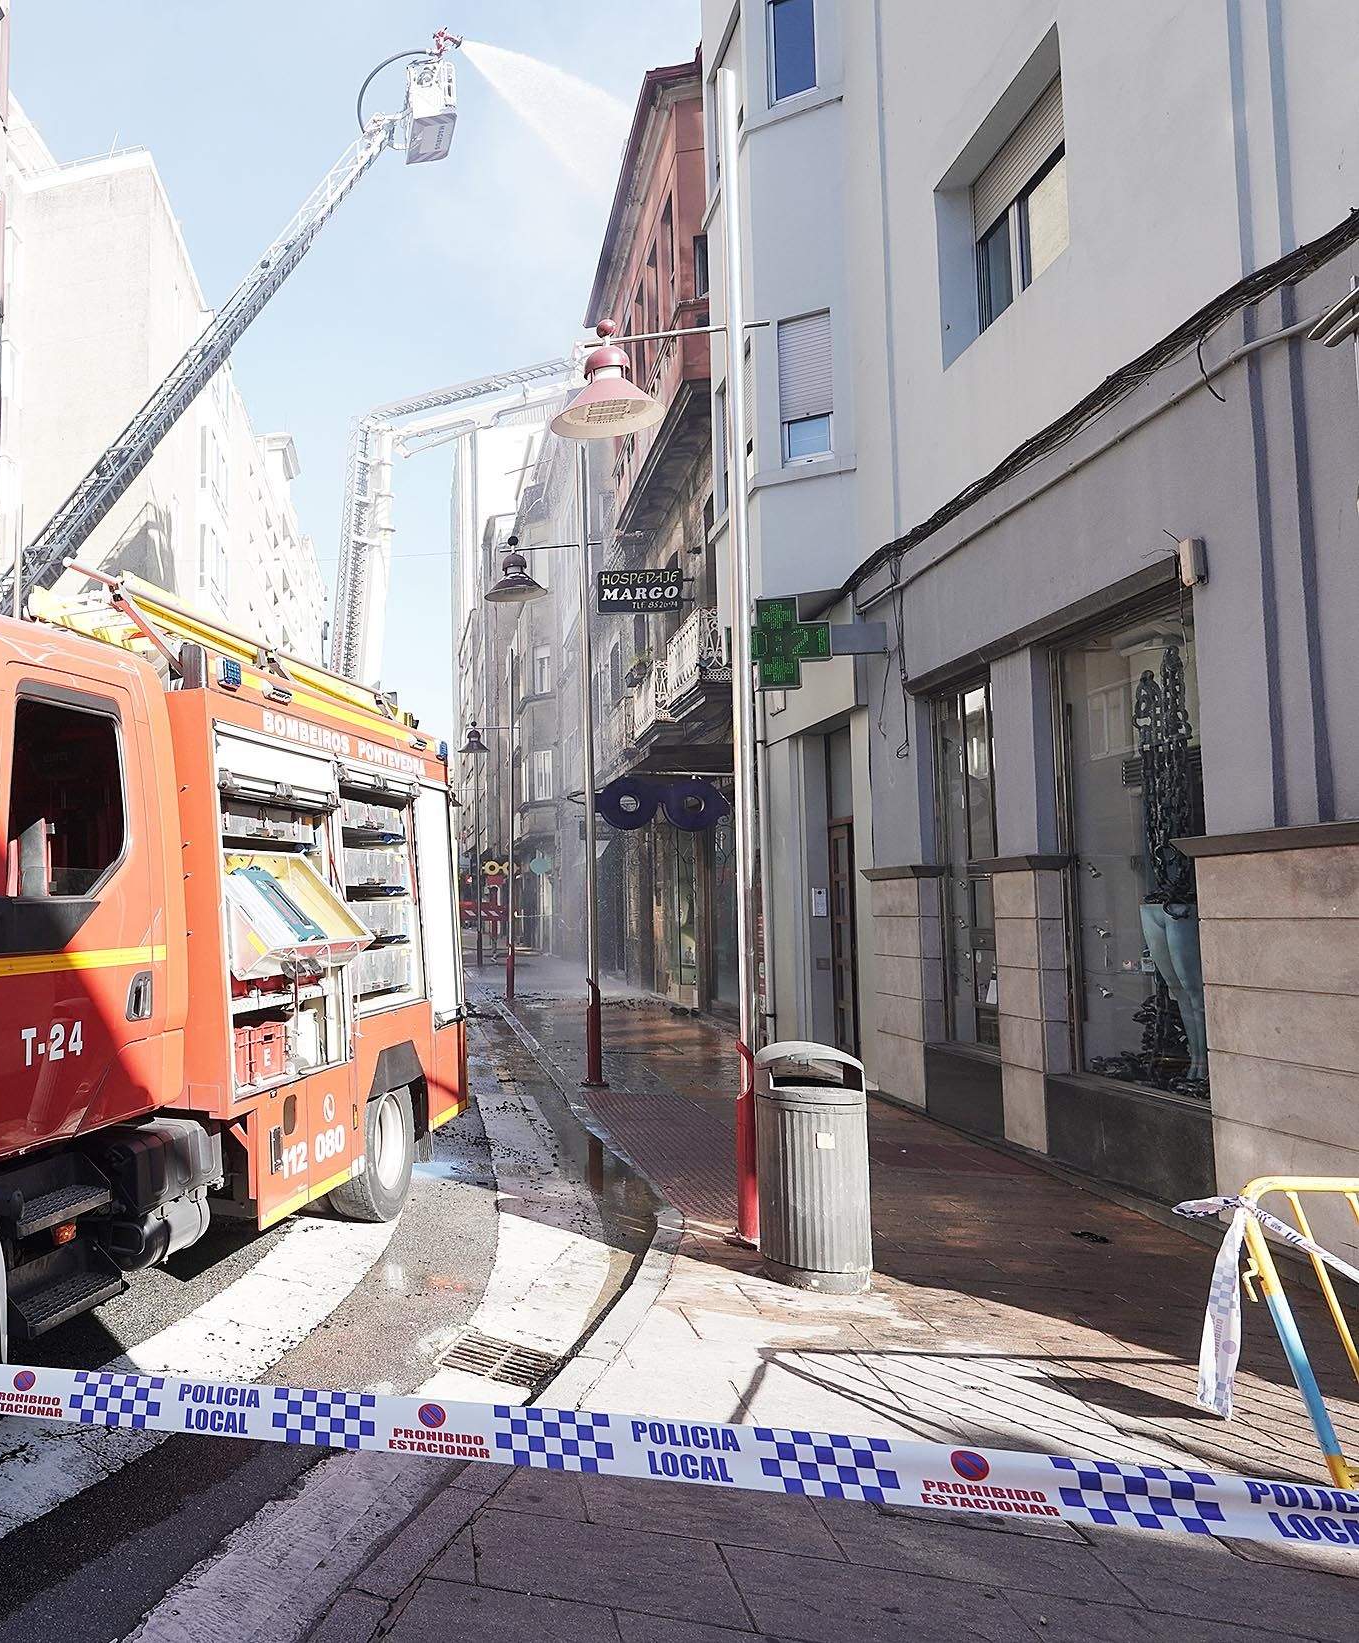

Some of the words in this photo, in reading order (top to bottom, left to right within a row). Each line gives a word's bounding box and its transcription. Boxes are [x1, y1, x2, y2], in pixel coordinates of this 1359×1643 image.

[601, 570, 679, 585] HOSPEDAJE
[601, 586, 679, 600] MARGO
[262, 709, 350, 755] BOMBEIROS
[357, 740, 427, 777] PONTEVEDRA
[21, 1021, 84, 1067] T-24
[281, 1141, 308, 1179] 112
[314, 1123, 346, 1163] 080
[178, 1383, 261, 1408] POLICIA
[185, 1408, 248, 1434] LOCAL
[393, 1428, 484, 1446] PROHIBIDO
[631, 1420, 741, 1452] POLICIA
[388, 1439, 490, 1459] ESTACIONAR
[648, 1450, 734, 1483] LOCAL
[922, 1479, 1047, 1503] PROHIBIDO
[920, 1493, 1061, 1517] ESTACIONAR
